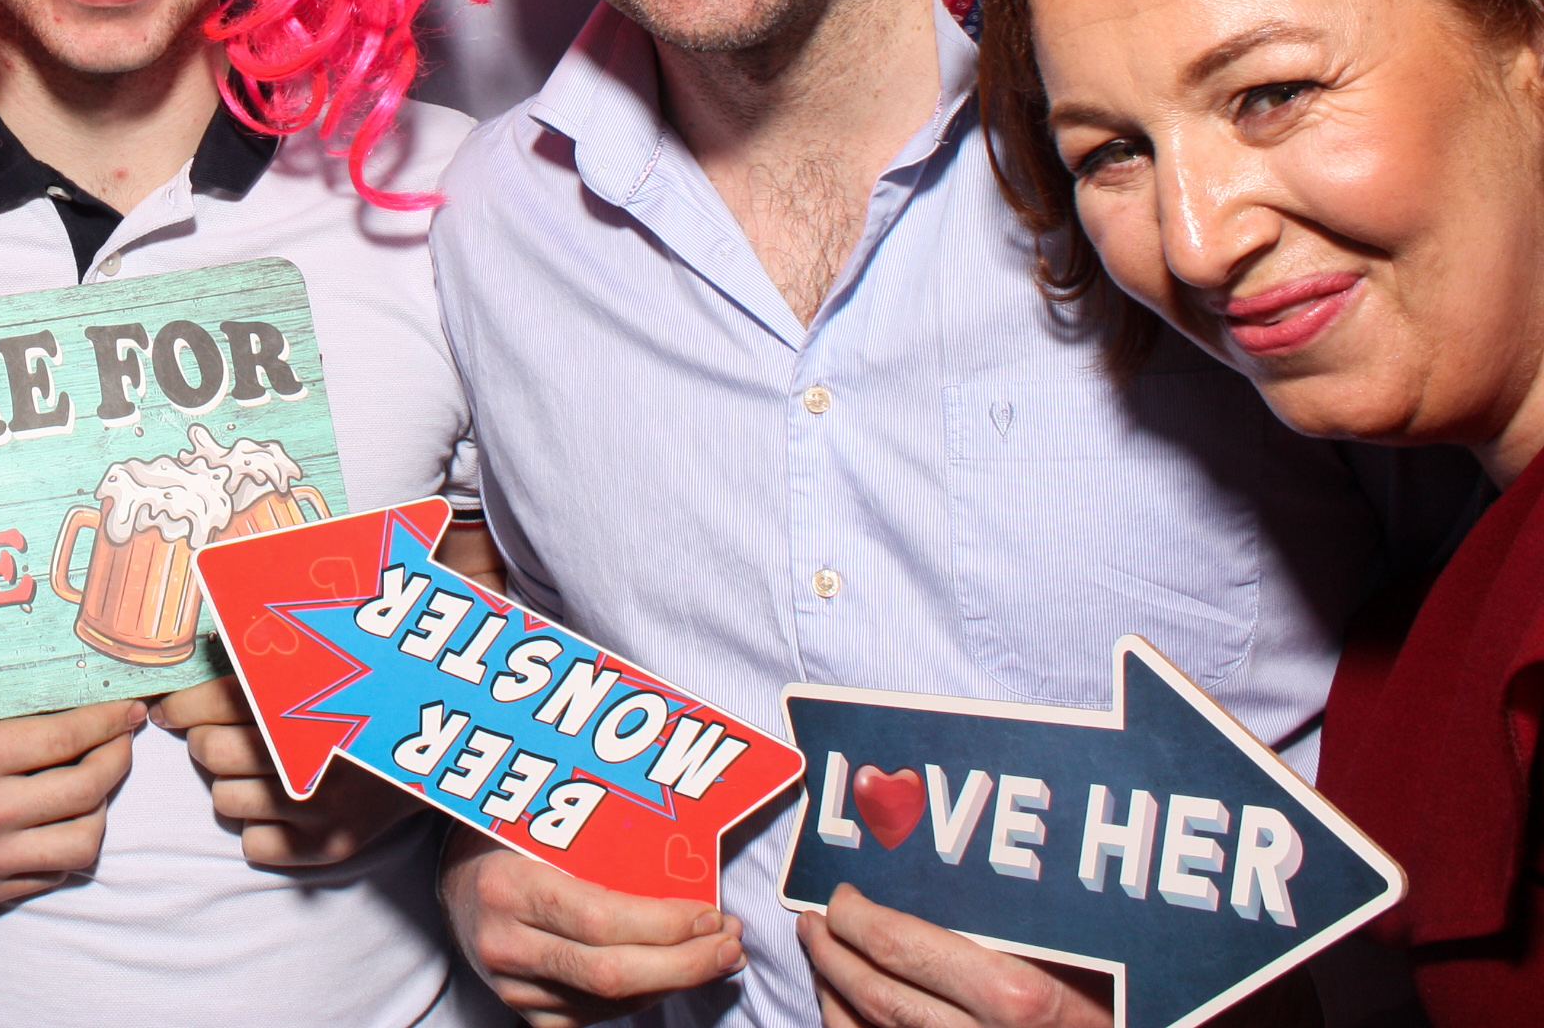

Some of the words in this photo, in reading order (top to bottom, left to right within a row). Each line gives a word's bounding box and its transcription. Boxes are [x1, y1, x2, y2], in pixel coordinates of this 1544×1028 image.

[84, 319, 309, 428] FOR
[354, 563, 751, 800] MONSTER
[392, 700, 608, 851] BEER
[1078, 783, 1304, 928] HER
